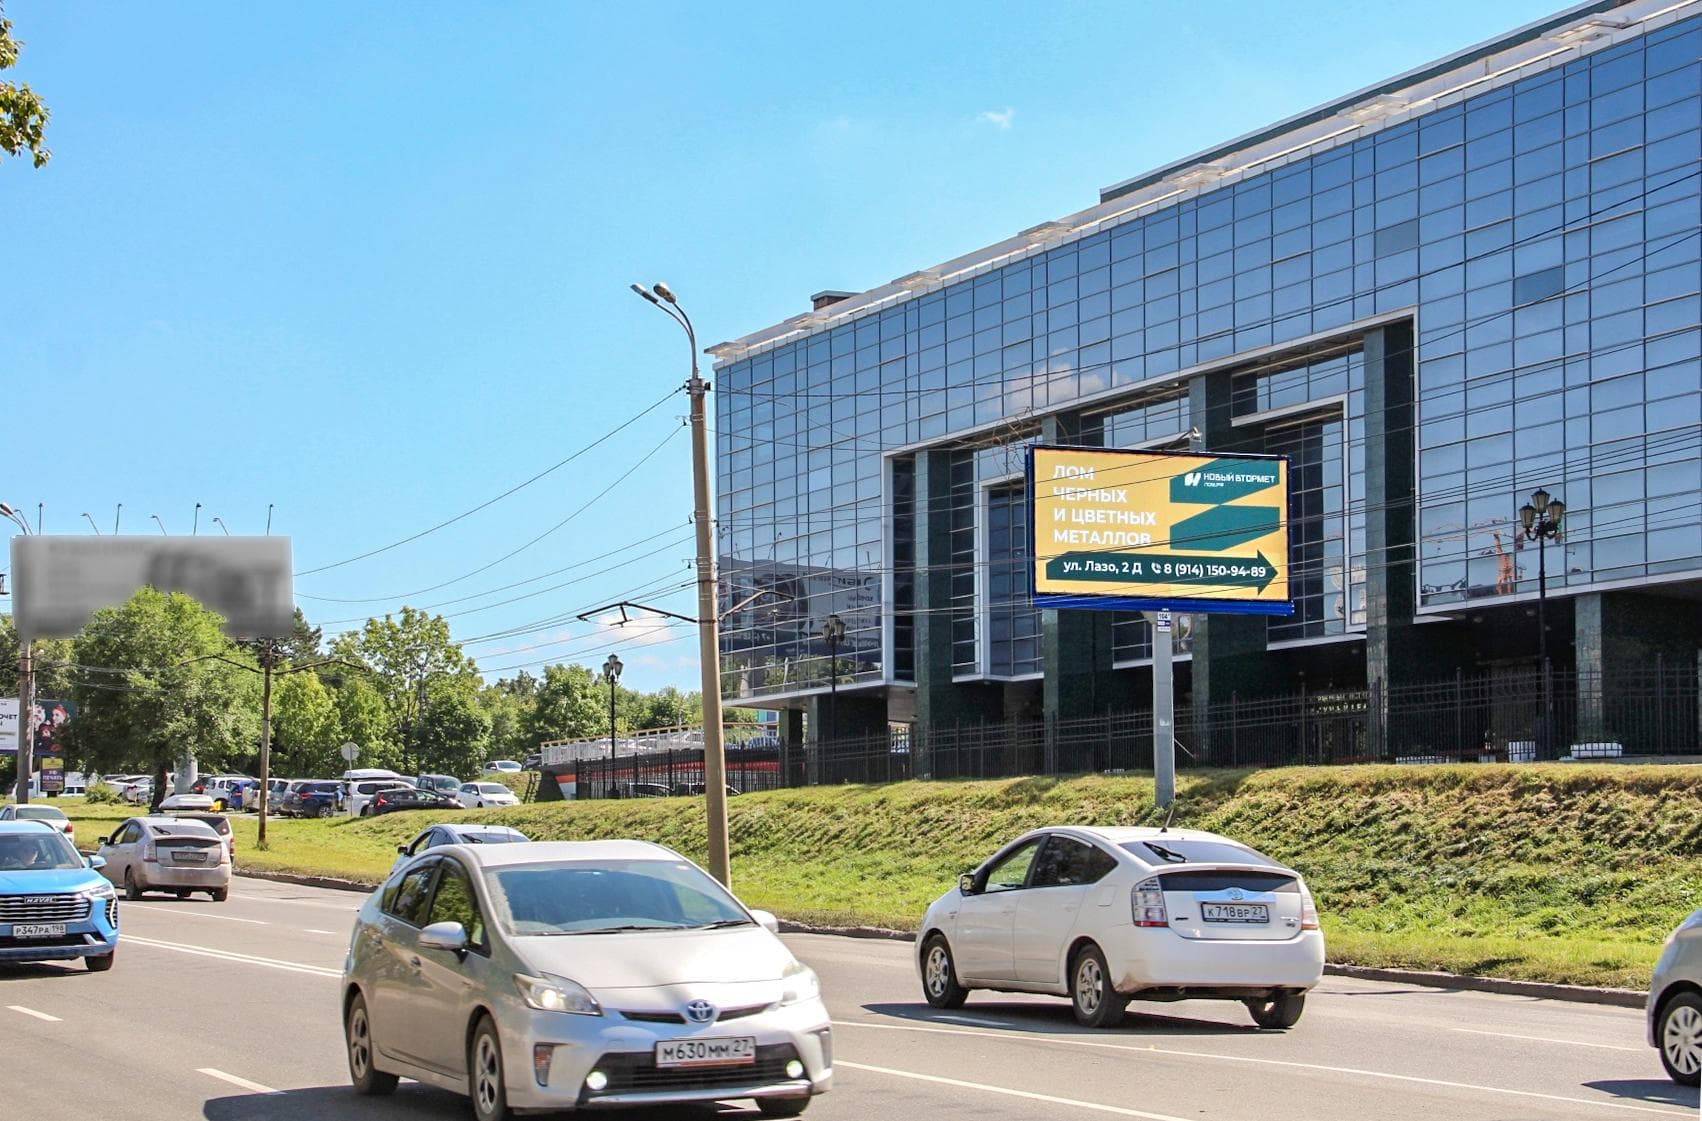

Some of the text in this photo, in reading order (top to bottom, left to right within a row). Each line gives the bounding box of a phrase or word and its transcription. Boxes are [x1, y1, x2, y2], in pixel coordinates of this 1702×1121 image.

[1052, 465, 1095, 480] ЛОМ
[1203, 472, 1276, 484] НОВЫЙ ВТОРМЕТ
[1053, 487, 1128, 503] ЧЕРНЫХ
[1054, 508, 1157, 525] И ЦВЕТНЫХ
[1054, 529, 1152, 545] МЕТАЛЛОВ
[1063, 561, 1143, 575] ул. Лазо, 2 Д
[1163, 563, 1266, 577] 8 (914) 150-94-89
[1208, 906, 1249, 917] К718ВР
[663, 1040, 748, 1060] М630ММ 27
